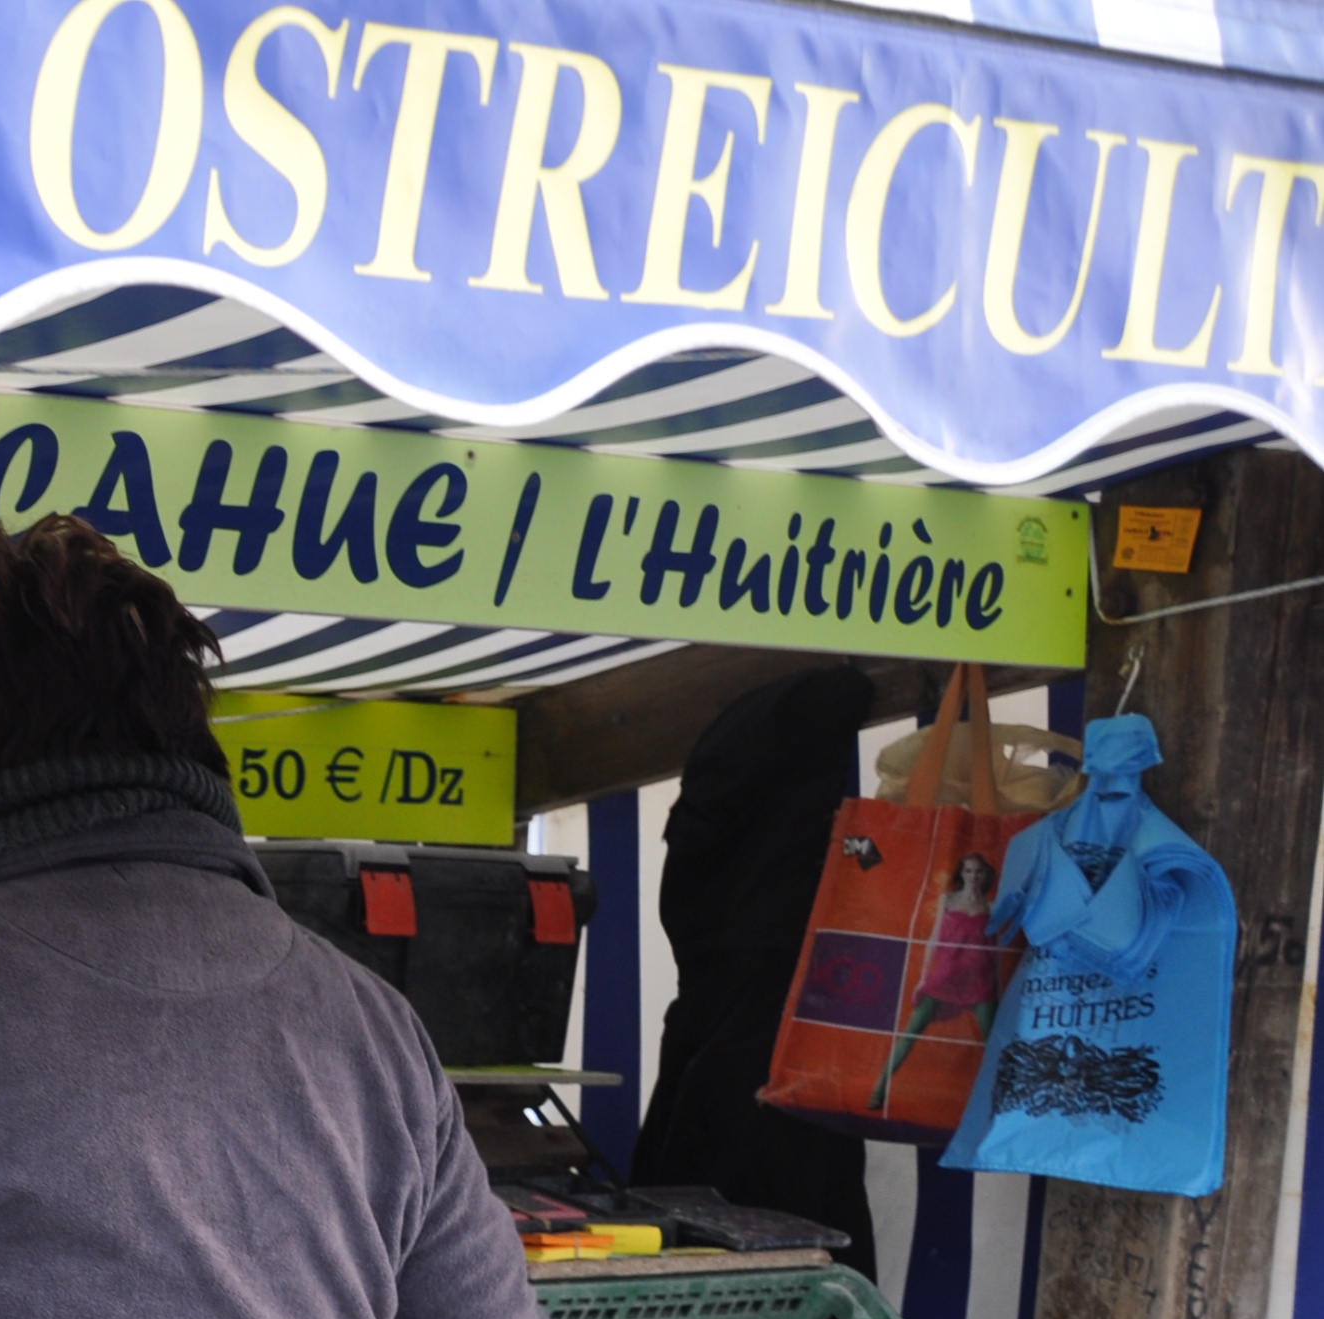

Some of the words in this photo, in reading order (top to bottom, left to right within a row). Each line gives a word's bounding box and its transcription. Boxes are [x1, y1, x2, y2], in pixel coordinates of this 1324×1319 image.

[495, 471, 541, 608] /
[571, 492, 1005, 631] L'Huitrière
[239, 747, 306, 801] 50
[325, 746, 365, 803] €
[1032, 992, 1155, 1029] HUÎTRES
